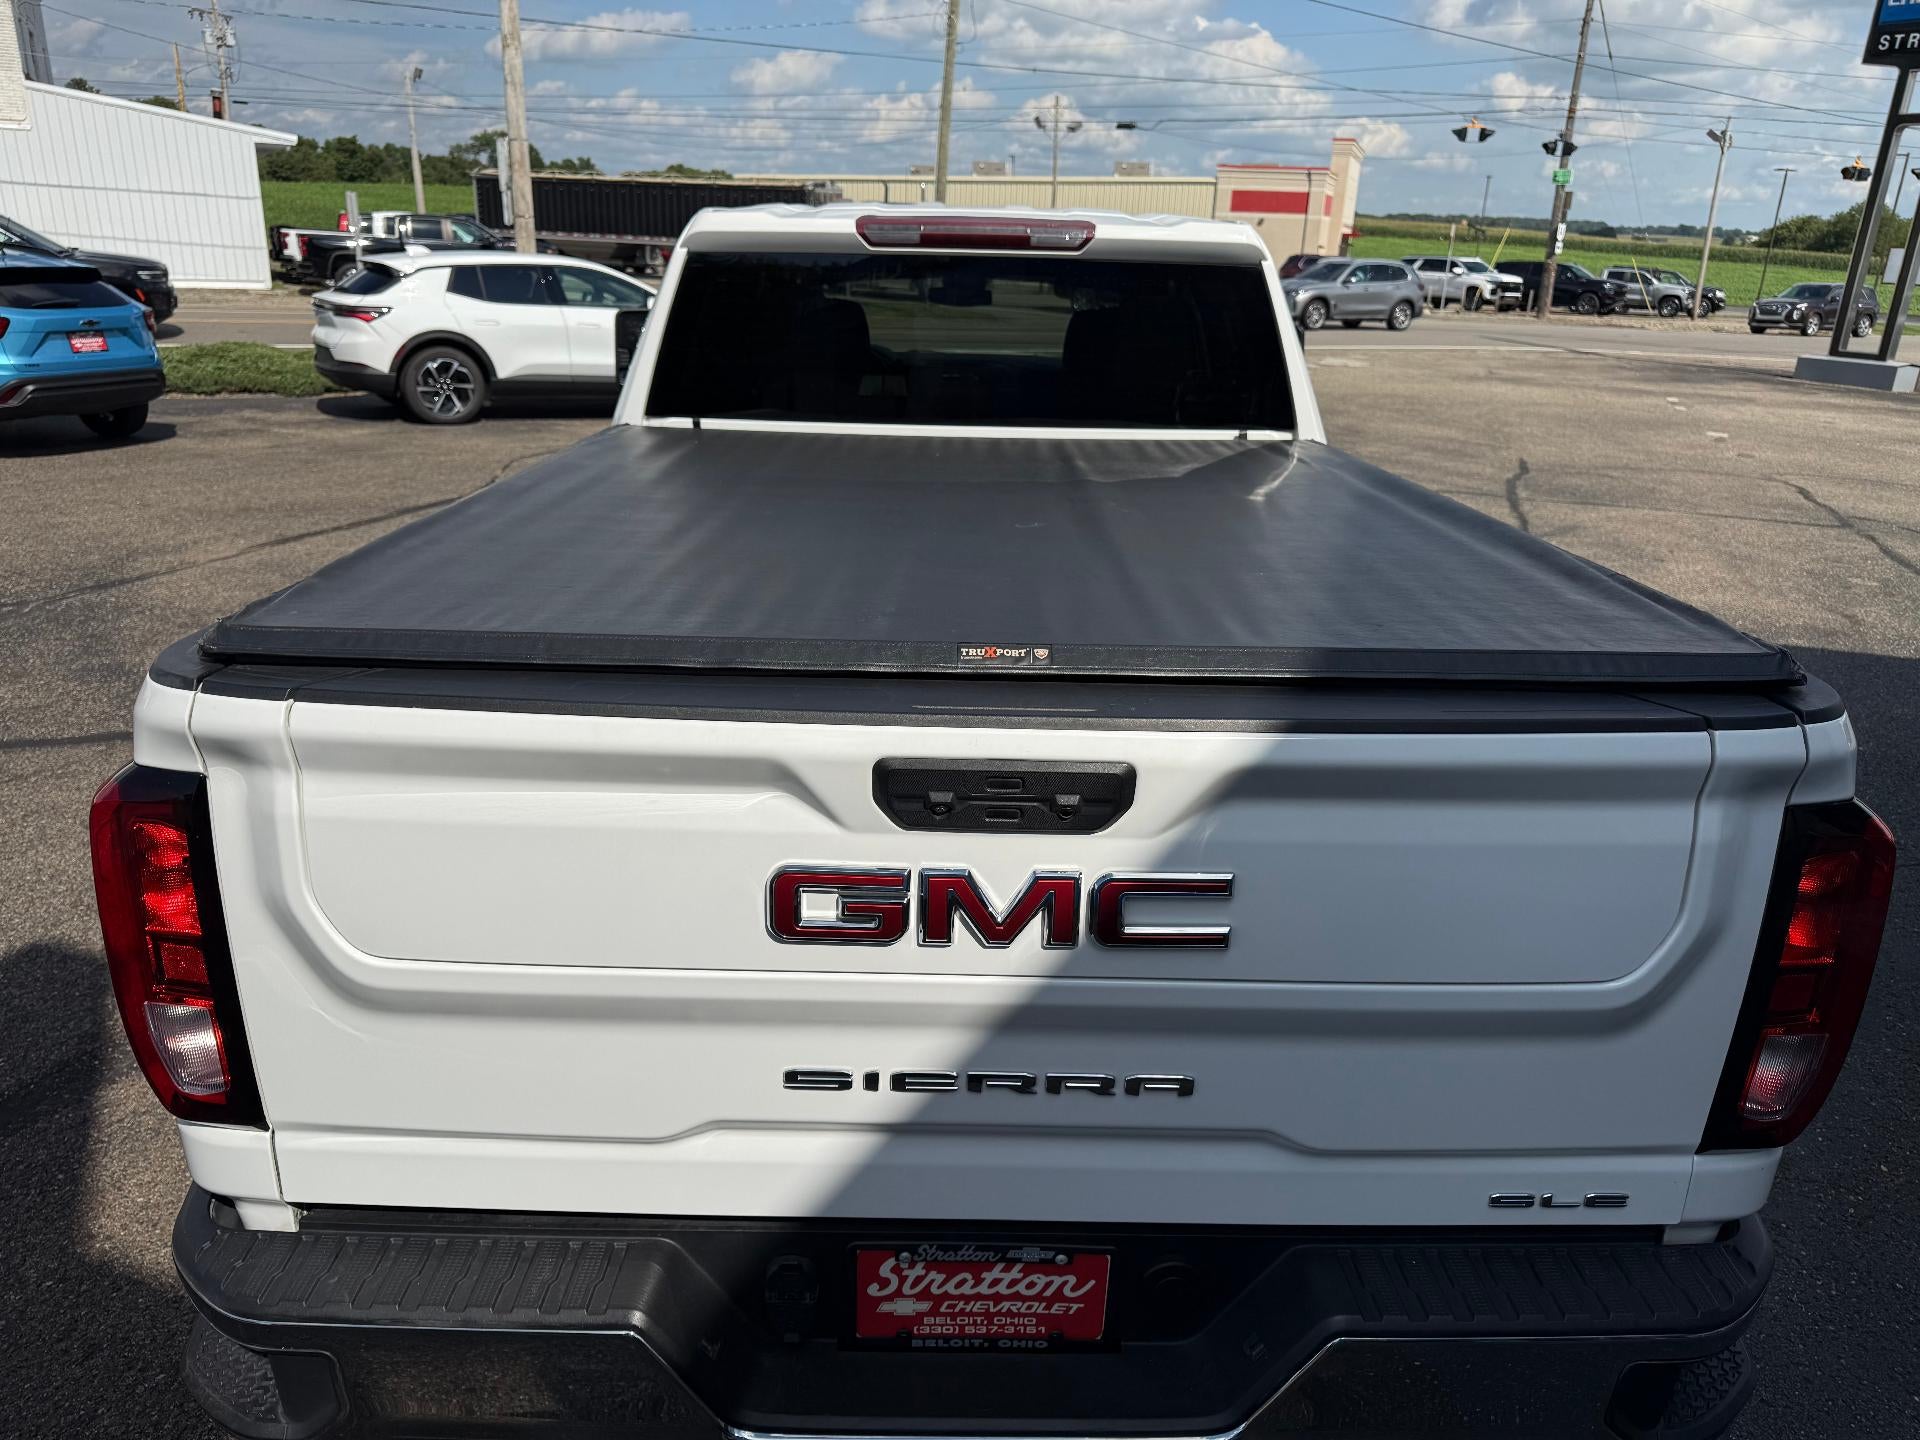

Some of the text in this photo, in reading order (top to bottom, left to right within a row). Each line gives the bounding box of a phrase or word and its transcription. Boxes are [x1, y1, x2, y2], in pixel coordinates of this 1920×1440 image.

[1878, 33, 1920, 50] STR
[960, 646, 1027, 658] TRUXPORT
[766, 865, 1235, 949] GMC
[782, 1069, 1195, 1096] SIERRA
[1488, 1193, 1629, 1208] SLE
[913, 1244, 1002, 1262] Stratton
[867, 1258, 1096, 1298] Stratton
[939, 1300, 1085, 1315] CHEVROLET
[923, 1316, 1037, 1326] BELOIT, OHIO
[913, 1325, 1047, 1335] (330) 537-3151
[997, 1339, 1049, 1349] OHIO
